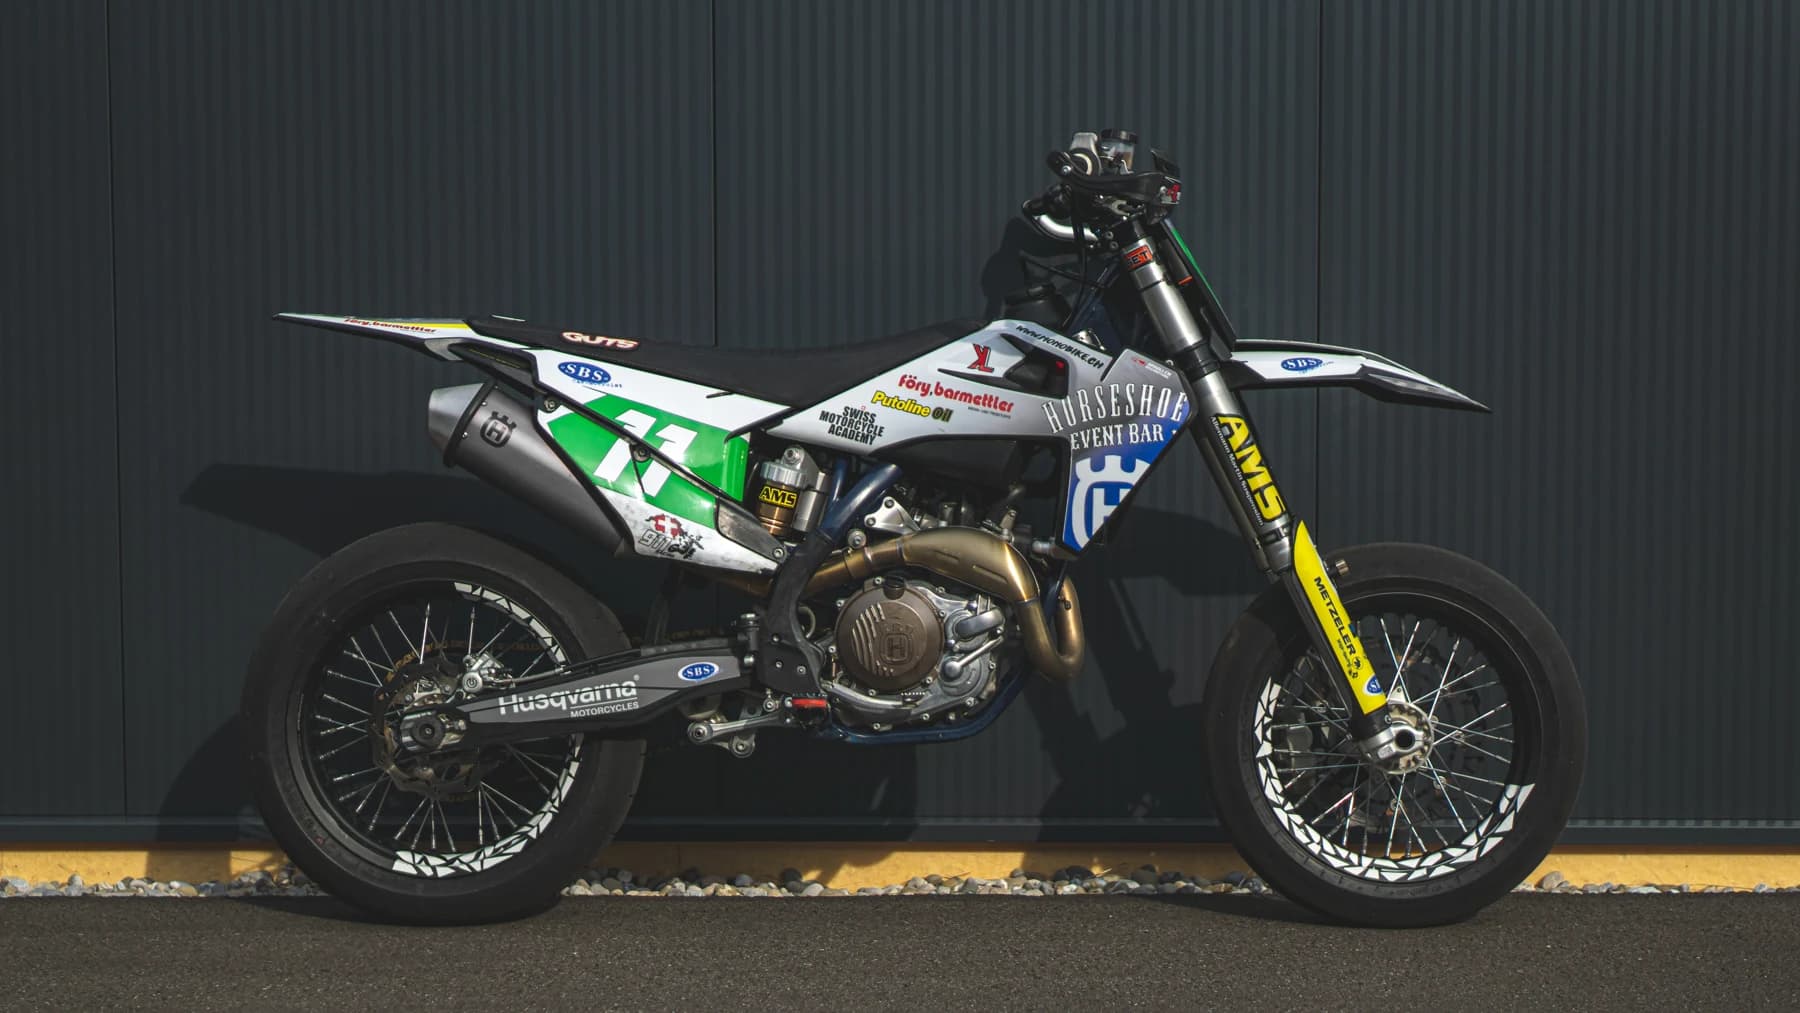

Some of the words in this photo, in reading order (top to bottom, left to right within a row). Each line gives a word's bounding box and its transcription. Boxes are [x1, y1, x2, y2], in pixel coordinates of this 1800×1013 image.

[561, 331, 640, 349] GUTS
[564, 362, 604, 382] SBS
[842, 405, 877, 424] SWISS
[871, 389, 932, 417] Putoline
[931, 406, 954, 423] Oil
[1041, 383, 1188, 434] HORSESHOE
[819, 410, 885, 437] MOTORCYCLE
[828, 423, 876, 446] ACADEMY
[1070, 424, 1124, 450] EVENT
[1128, 423, 1164, 445] BAR
[1217, 416, 1287, 520] AMS
[759, 486, 798, 508] AMS
[1228, 453, 1243, 481] Martin
[1241, 480, 1264, 526] Suspension
[1314, 577, 1357, 655] METZELER
[498, 680, 638, 715] Husqvarna
[569, 701, 640, 718] MOTORCYCLES
